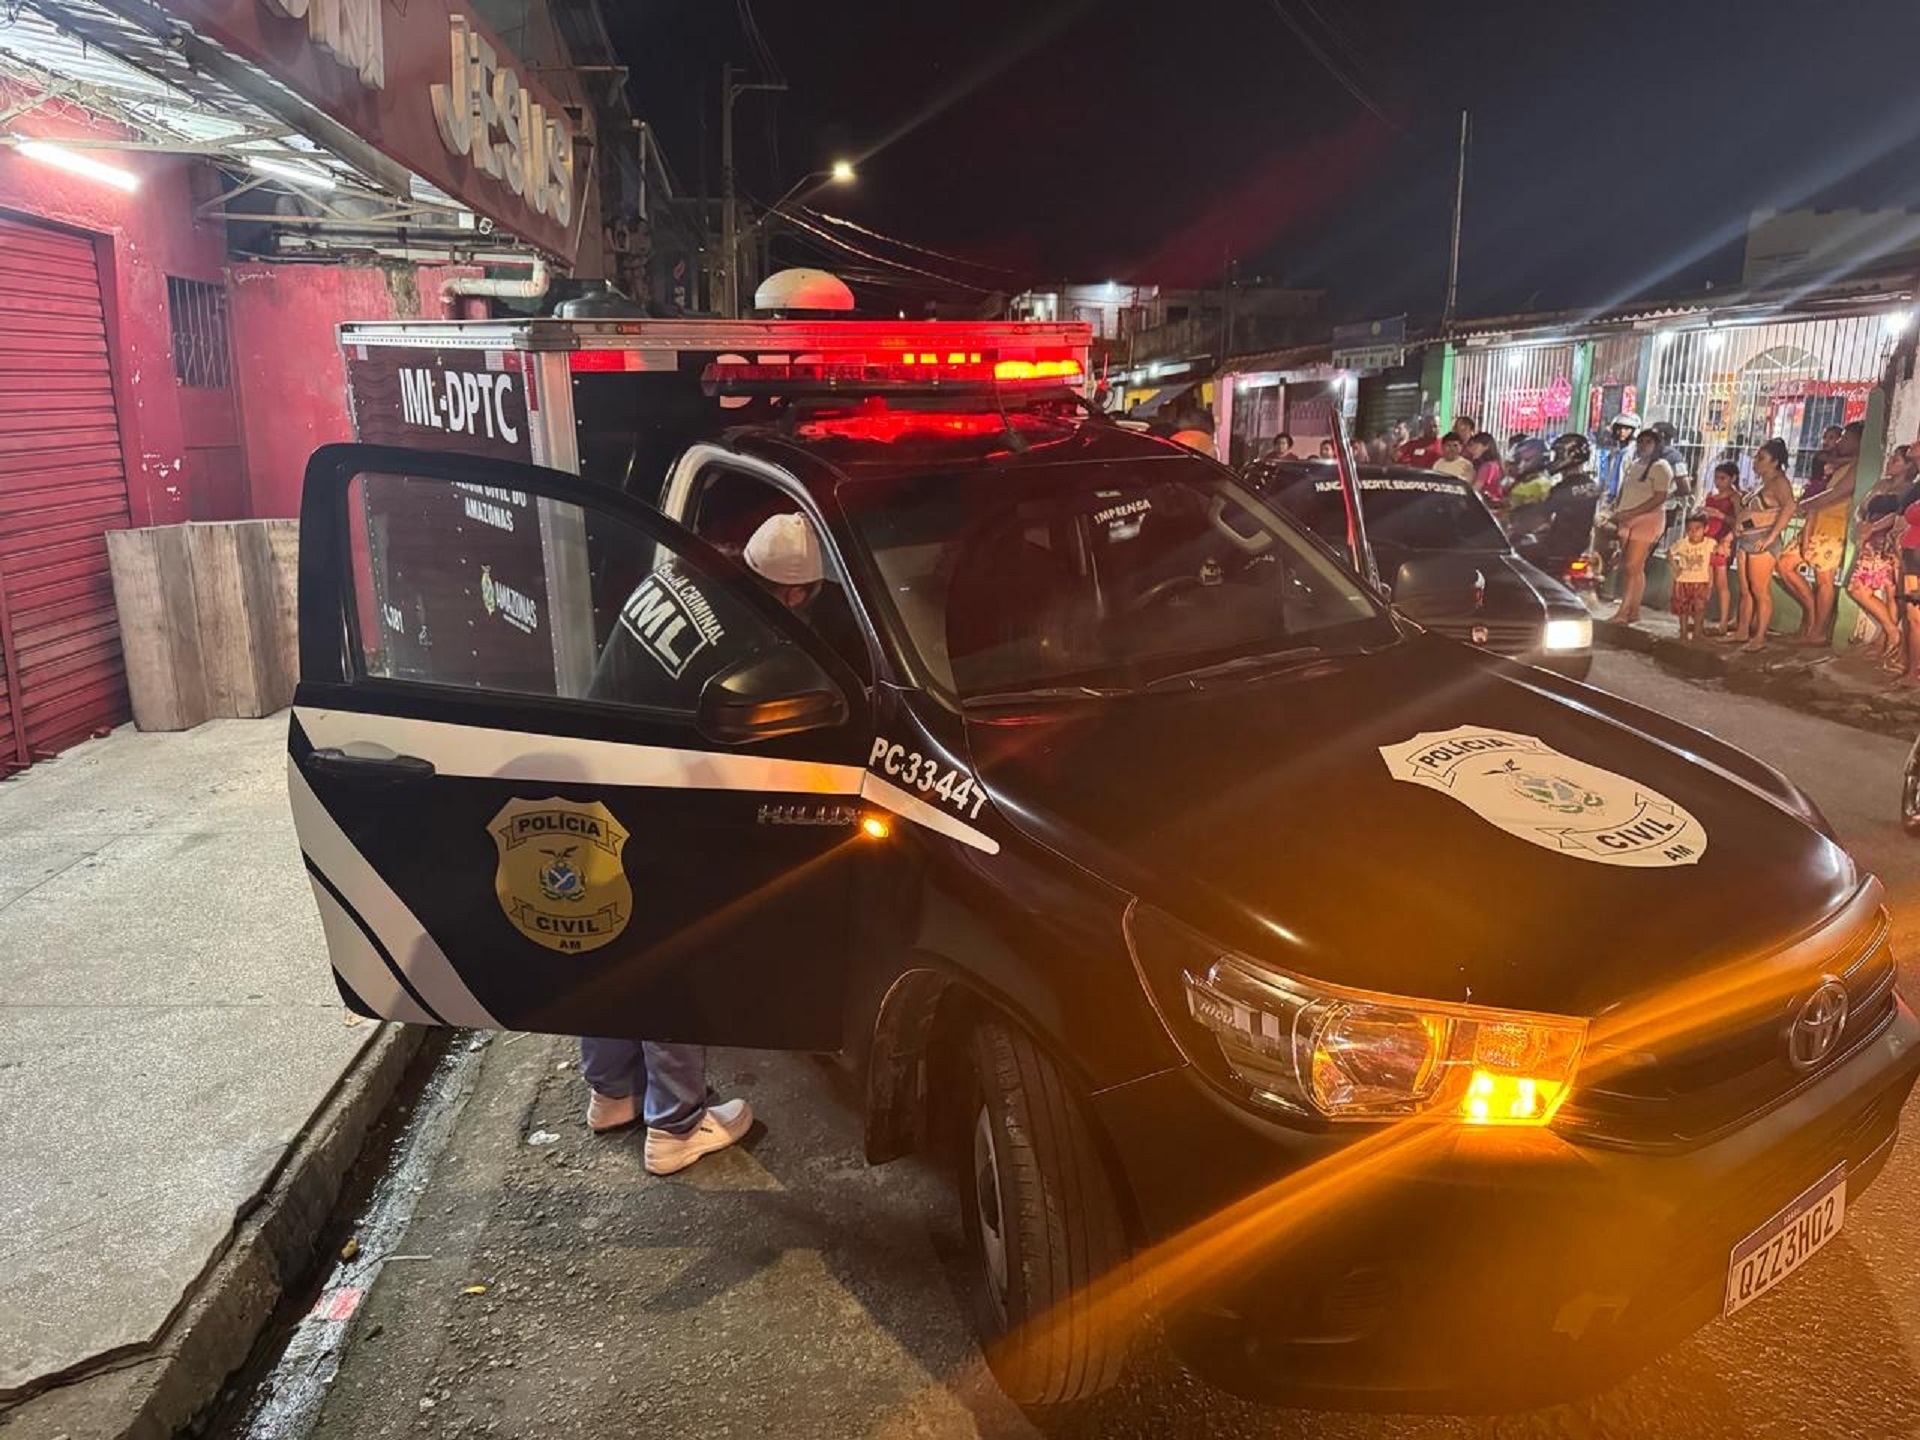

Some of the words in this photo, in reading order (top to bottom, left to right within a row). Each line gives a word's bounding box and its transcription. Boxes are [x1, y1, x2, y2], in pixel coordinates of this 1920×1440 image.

[399, 368, 518, 444] IML-DPTC
[464, 496, 514, 532] AMAZONAS
[1094, 499, 1152, 524] IMPRENSA
[624, 580, 687, 667] IML
[680, 585, 725, 646] CRIMINAL
[1419, 739, 1512, 768] POLÍCIA
[518, 813, 601, 837] POLÍCIA
[1596, 817, 1675, 851] CIVIL
[1663, 844, 1695, 862] AM
[536, 917, 600, 934] CIVIL
[559, 940, 582, 950] AM
[1738, 1196, 1835, 1299] QZZ3H02
